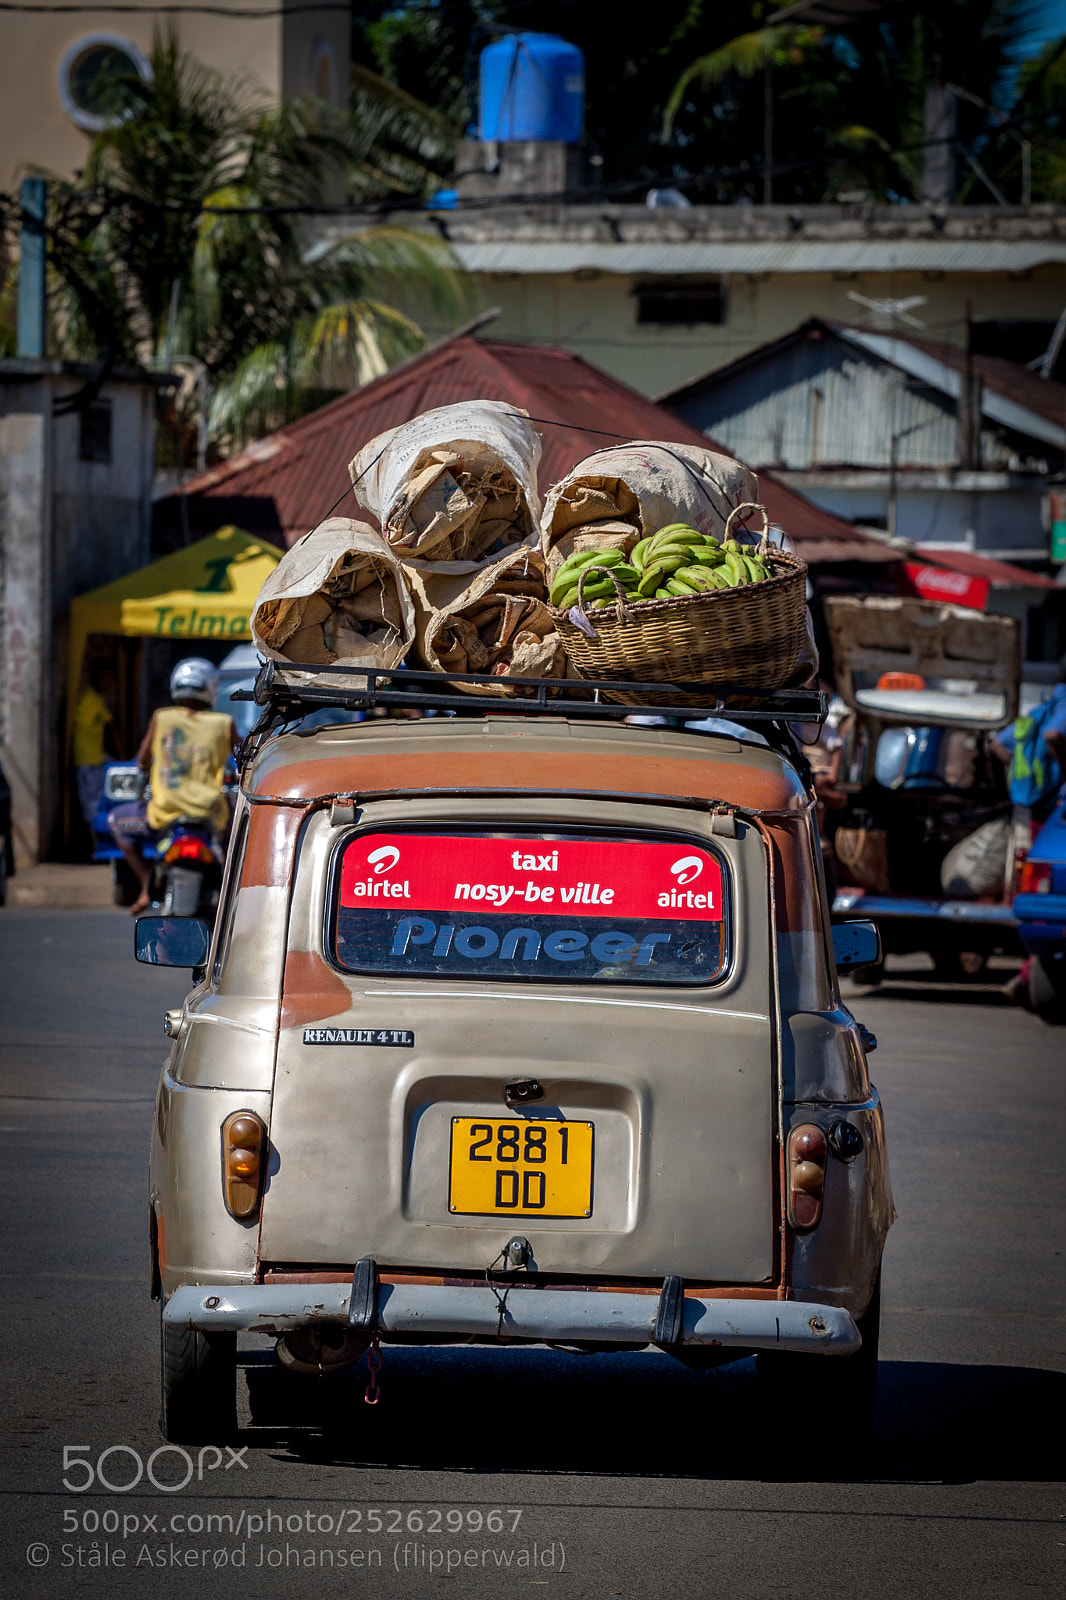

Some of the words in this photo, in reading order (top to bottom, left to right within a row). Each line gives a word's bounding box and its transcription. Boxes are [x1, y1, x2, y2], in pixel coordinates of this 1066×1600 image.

[154, 606, 248, 636] Telma
[511, 850, 559, 872] taxi
[353, 878, 411, 899] airtel
[454, 881, 554, 907] nosy-be
[560, 881, 615, 905] ville
[657, 888, 715, 910] airtel
[390, 916, 672, 966] Pioneer
[304, 1029, 375, 1043] RENAULT
[377, 1030, 389, 1043] 4
[390, 1031, 411, 1044] TL
[469, 1124, 569, 1165] 2881
[495, 1169, 546, 1209] DD
